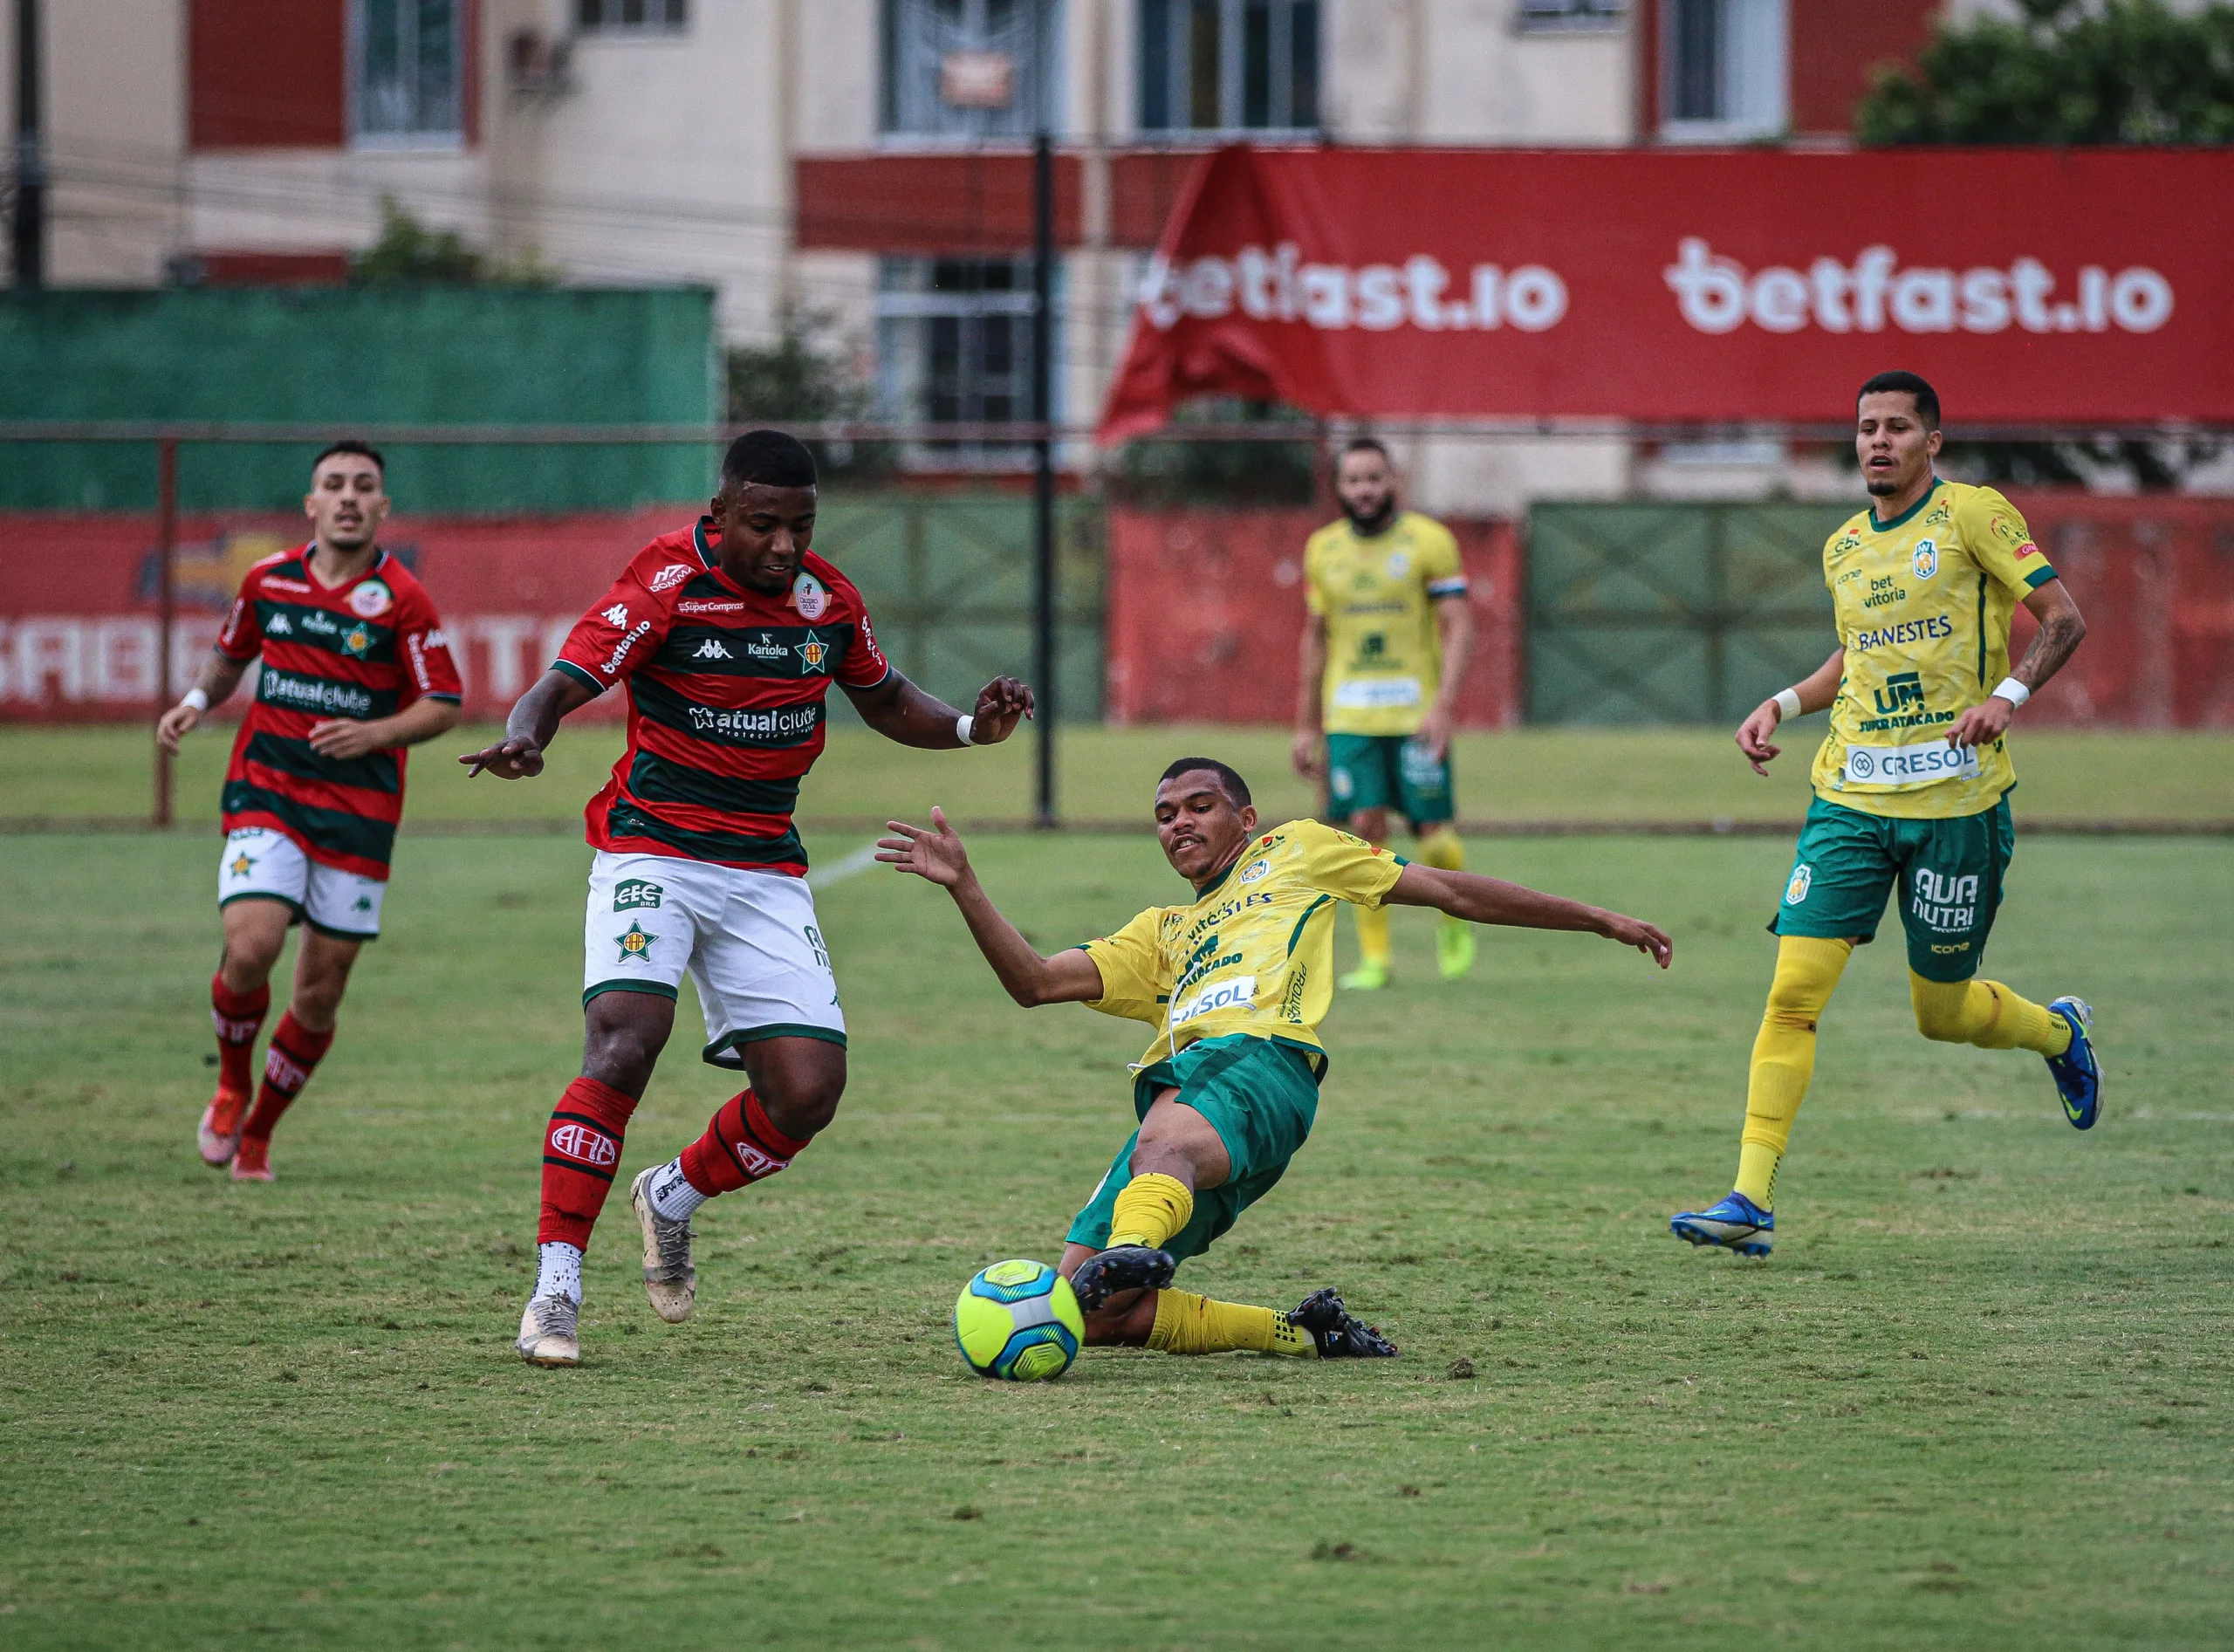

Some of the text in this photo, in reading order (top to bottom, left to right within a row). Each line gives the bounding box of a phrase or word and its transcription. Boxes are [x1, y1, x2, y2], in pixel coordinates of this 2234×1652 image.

[1870, 575, 1893, 591] bet
[1864, 586, 1906, 608] vitória
[1859, 615, 1953, 651] BANESTES
[748, 642, 788, 656] Karioka
[1882, 746, 1974, 776] CRESOL
